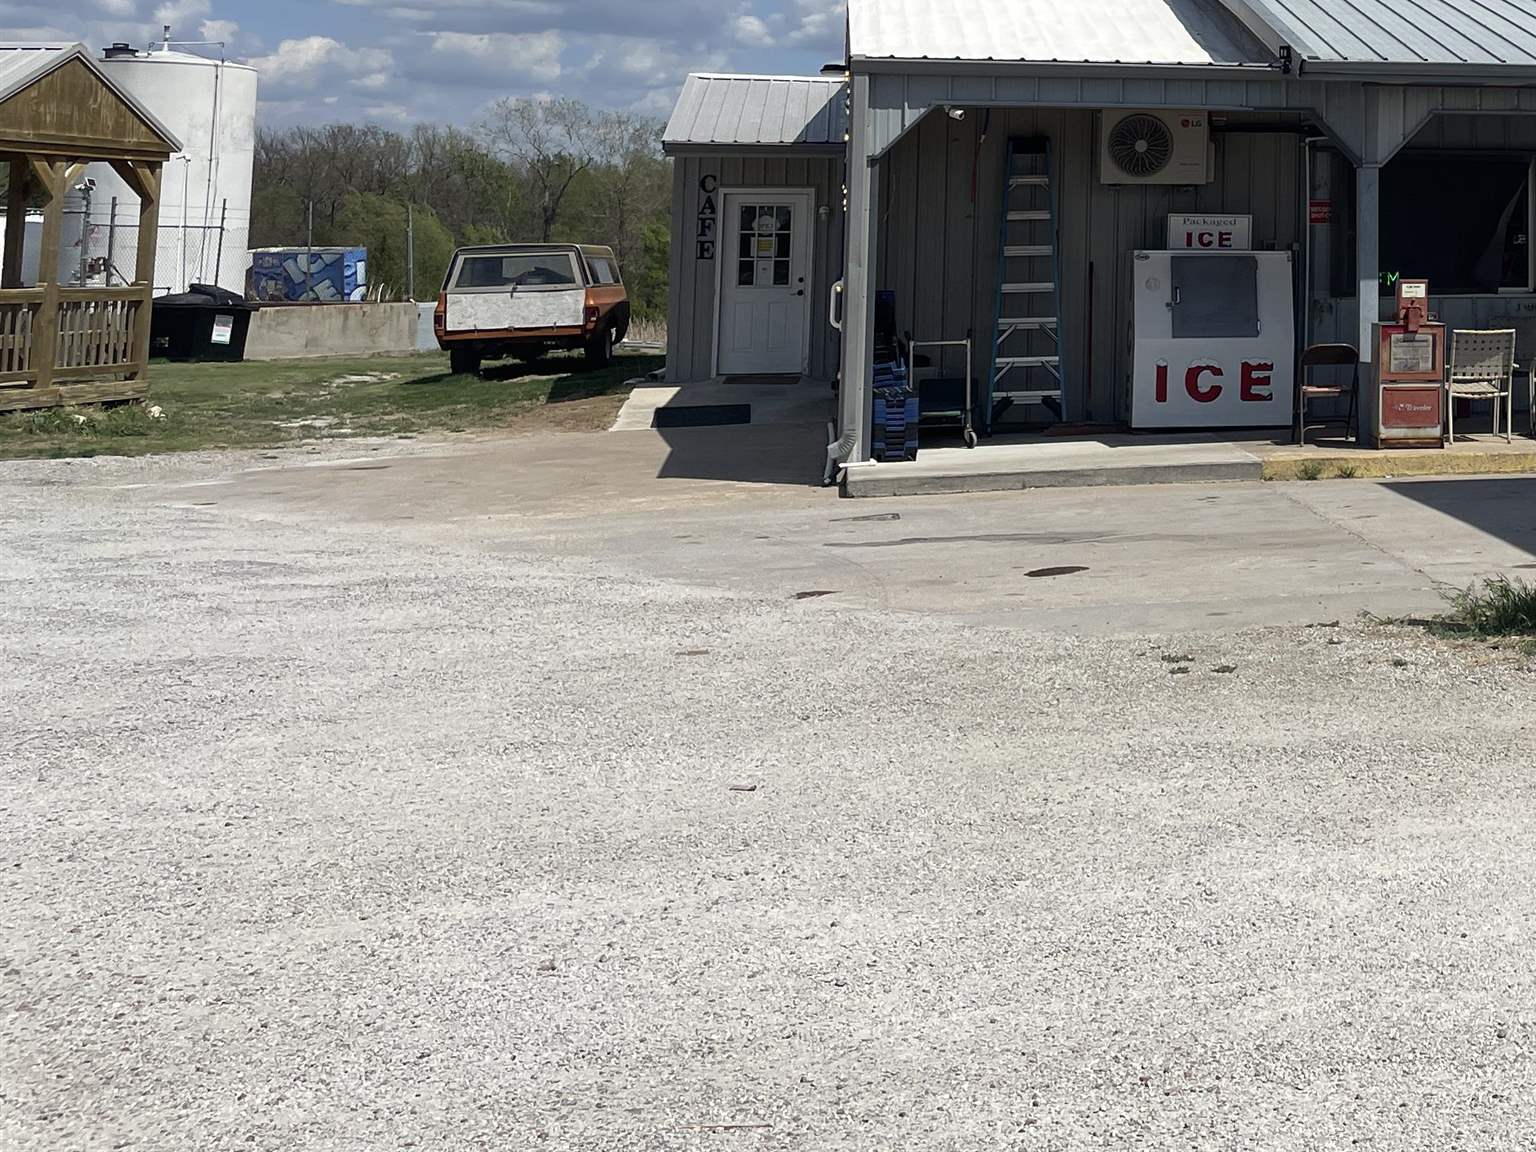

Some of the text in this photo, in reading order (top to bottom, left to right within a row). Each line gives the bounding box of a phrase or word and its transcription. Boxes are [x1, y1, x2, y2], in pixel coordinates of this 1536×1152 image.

[696, 174, 717, 260] CAFE
[1182, 217, 1237, 227] Packaged
[1186, 232, 1233, 248] ICE
[1155, 358, 1274, 403] ICE
